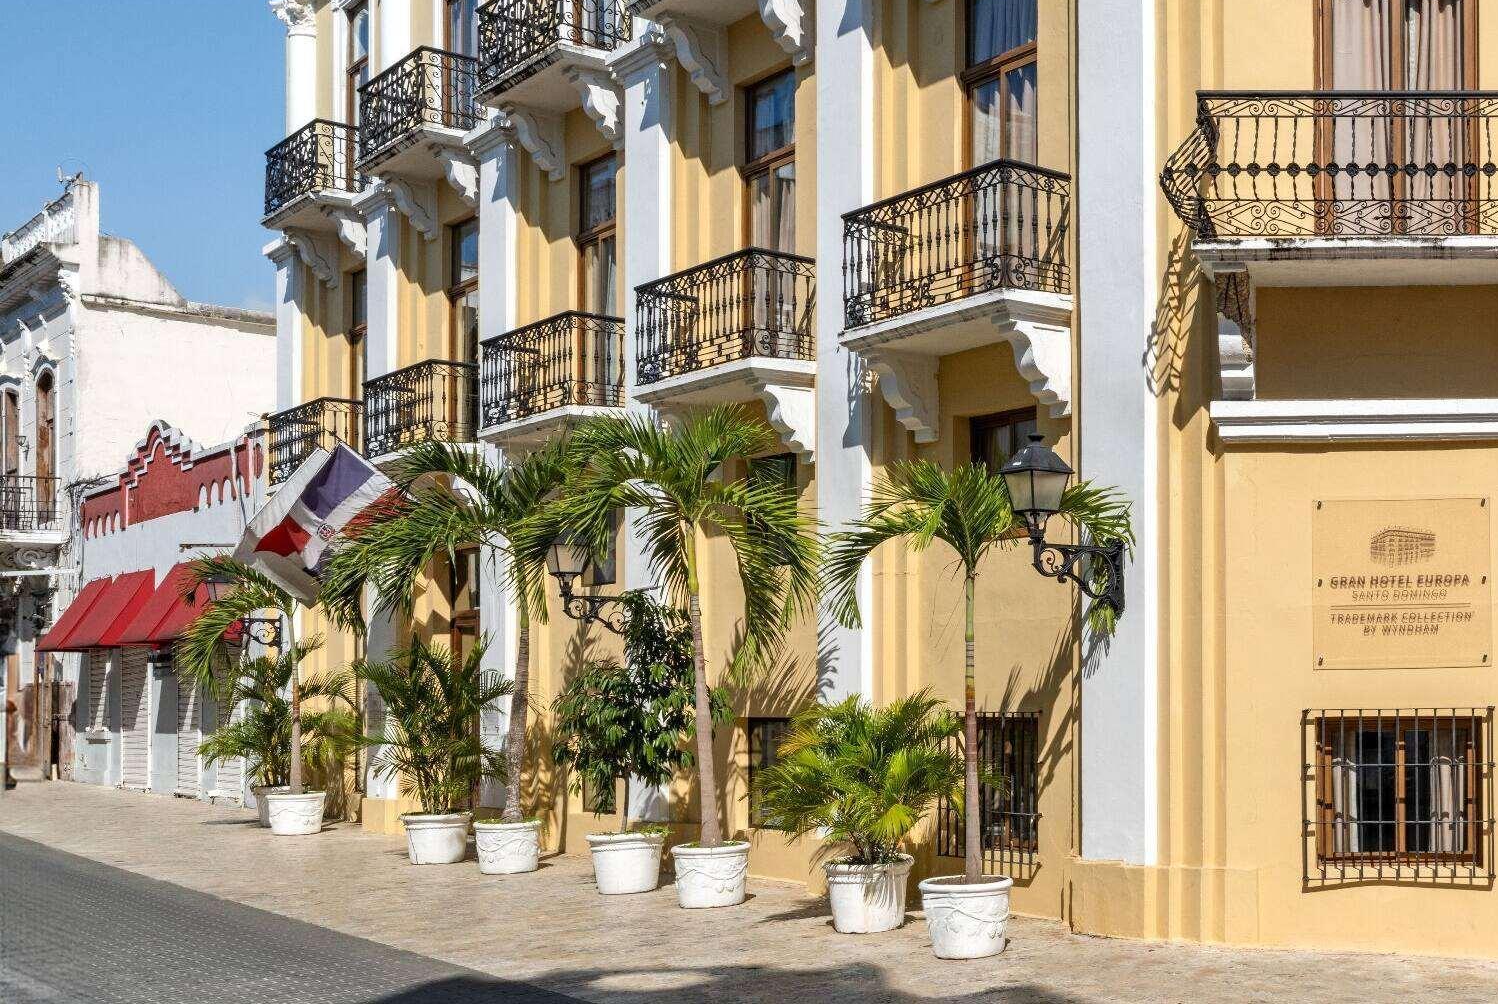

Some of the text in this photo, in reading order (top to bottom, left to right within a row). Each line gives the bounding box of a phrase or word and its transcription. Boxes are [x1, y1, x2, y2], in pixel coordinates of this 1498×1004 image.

[1330, 574, 1471, 589] GRAN HOTEL EUROPA
[1352, 589, 1448, 601] SANTO DOMINGO
[1330, 611, 1472, 624] TRADEMARK COLLECTION
[1364, 624, 1439, 636] BY WYNDHAM
